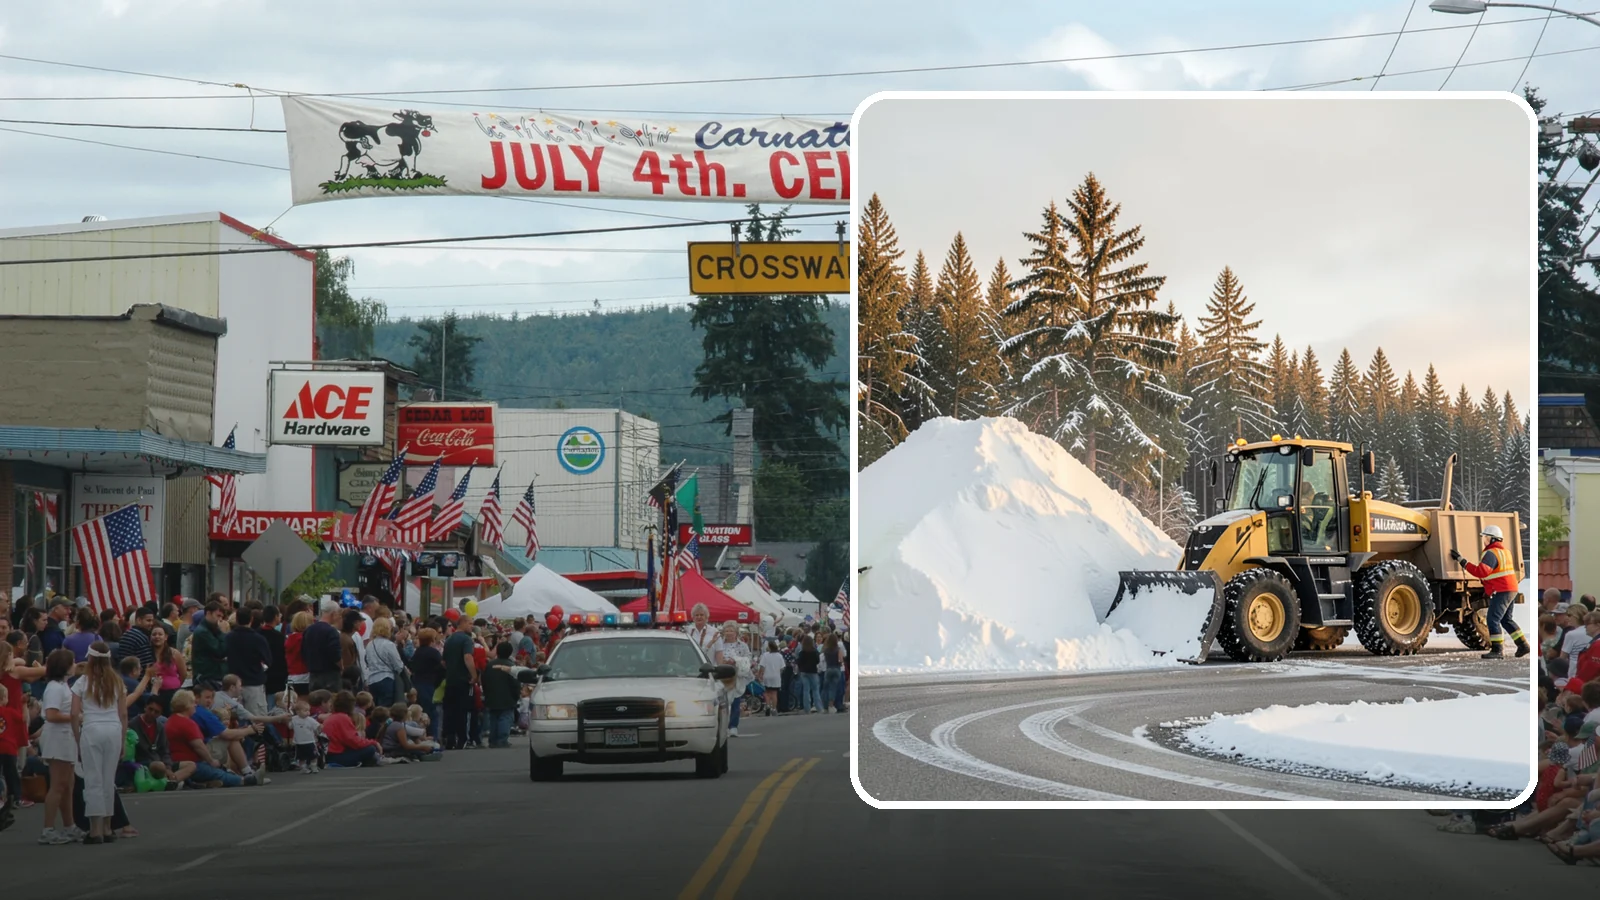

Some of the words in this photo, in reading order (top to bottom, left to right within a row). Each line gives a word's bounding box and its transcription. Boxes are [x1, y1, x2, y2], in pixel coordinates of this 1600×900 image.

[695, 121, 850, 149] Carnat
[482, 141, 605, 193] JULY
[632, 150, 746, 197] 4th.
[697, 254, 850, 279] CROSSWA
[283, 380, 373, 420] ACE
[406, 409, 452, 421] CEDAR
[283, 421, 370, 436] Hardware
[416, 428, 477, 447] Coca-Cola
[353, 467, 385, 481] Simpl
[83, 485, 93, 494] St.
[95, 485, 124, 494] Vincent
[126, 485, 136, 494] de
[137, 486, 155, 495] Paul
[212, 516, 330, 535] HARDARE
[688, 527, 741, 535] CRNATION
